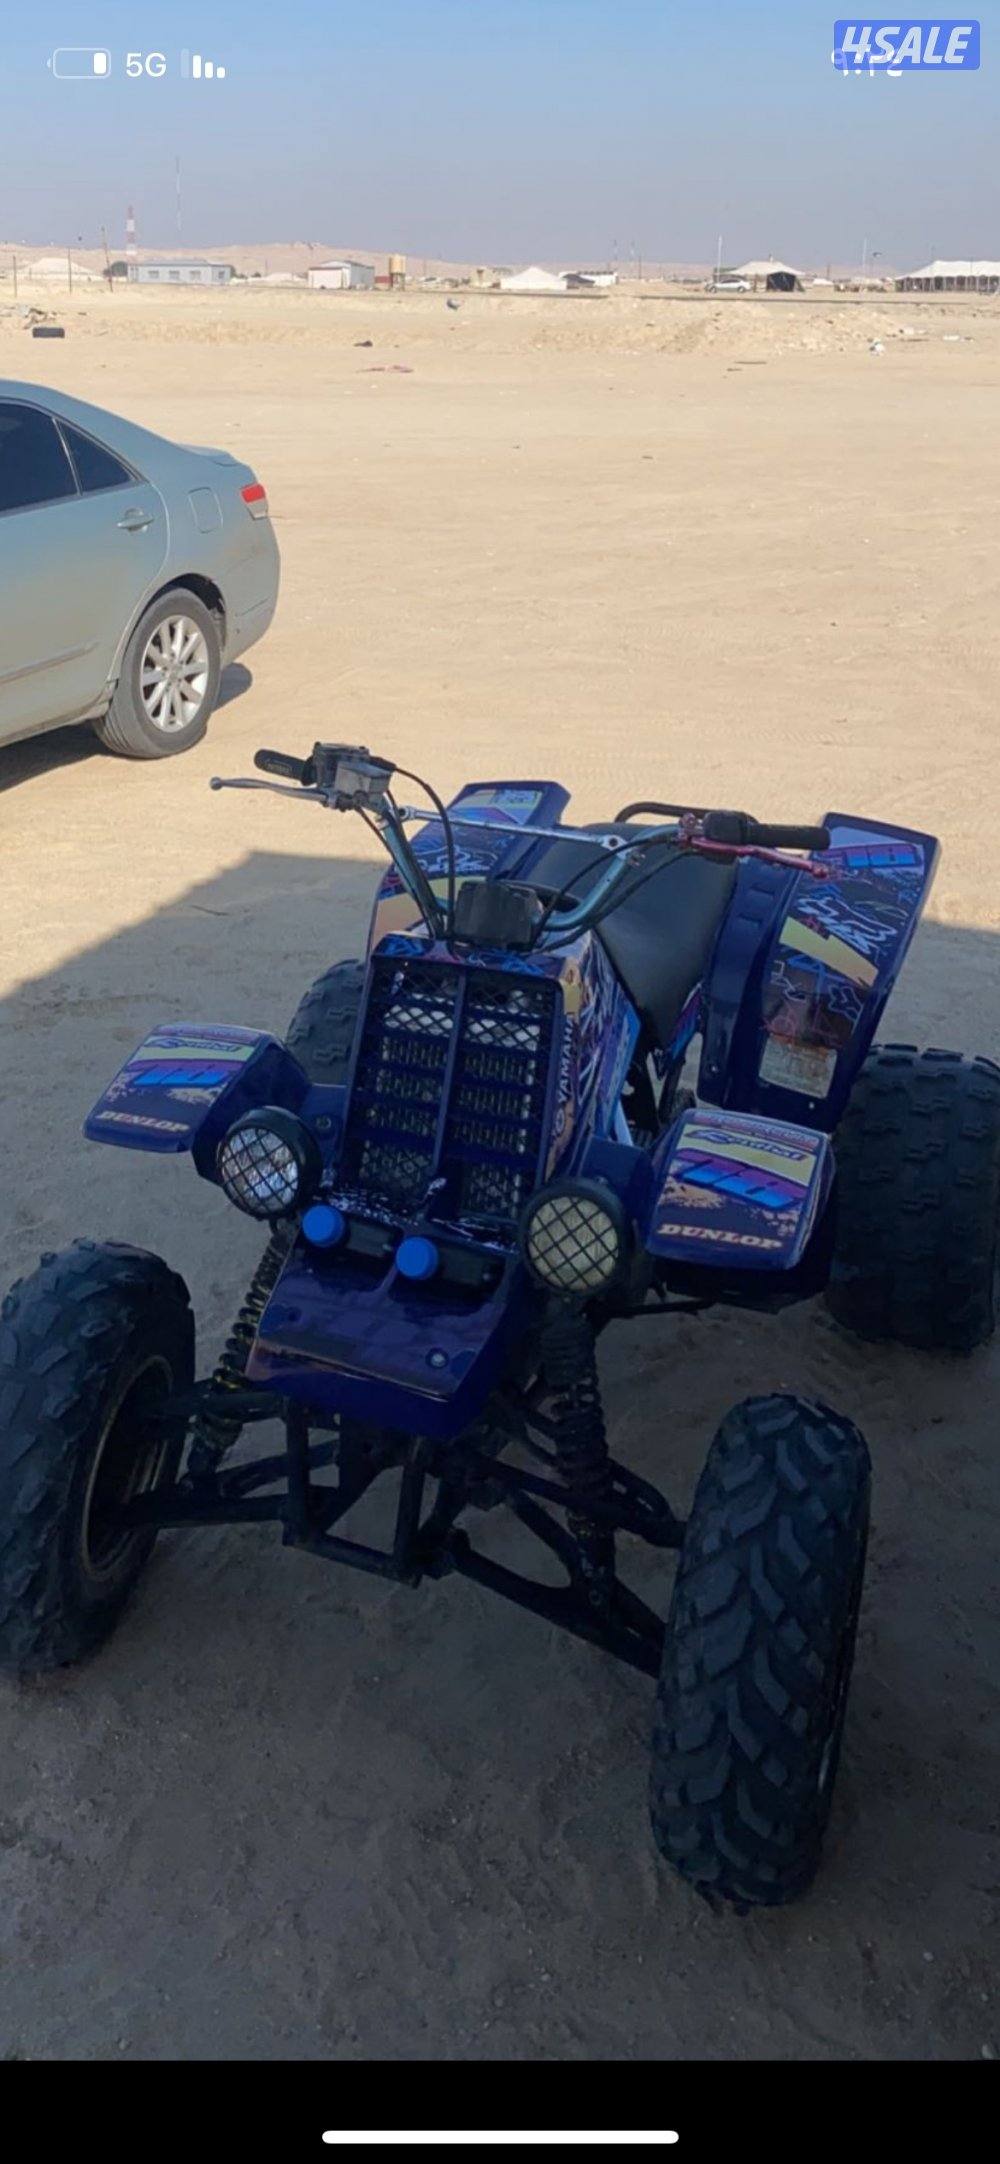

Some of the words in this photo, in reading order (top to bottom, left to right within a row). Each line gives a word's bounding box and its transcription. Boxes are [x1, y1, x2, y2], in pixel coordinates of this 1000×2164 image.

[556, 1013, 576, 1104] YAMAHA
[95, 1111, 190, 1133] DUNLOP
[657, 1223, 783, 1250] DUNLOP
